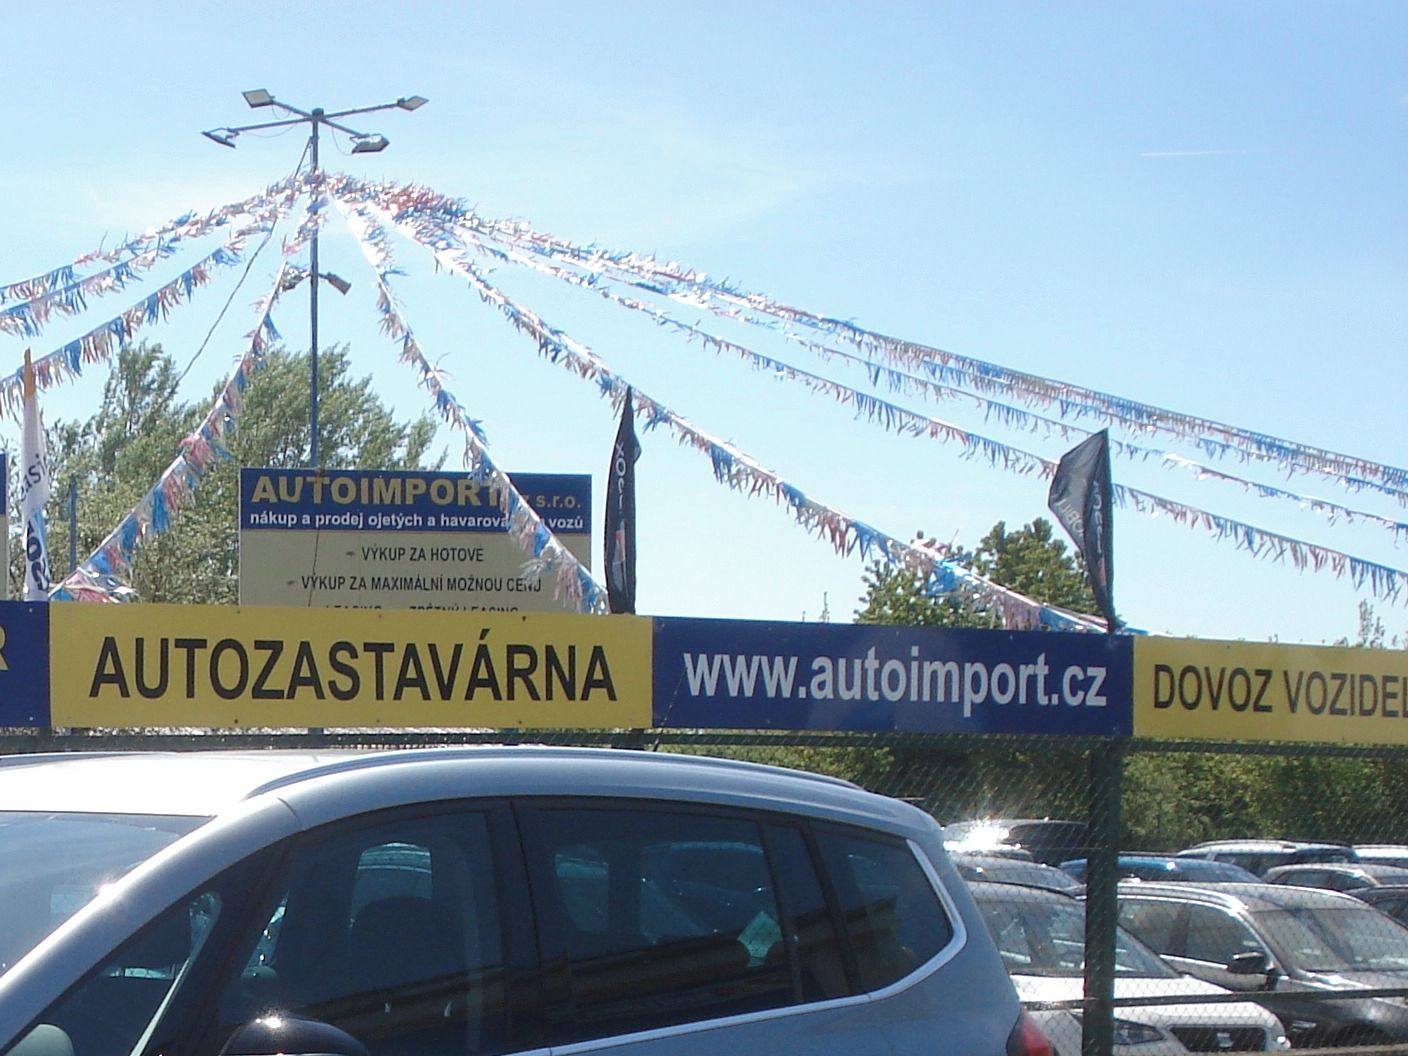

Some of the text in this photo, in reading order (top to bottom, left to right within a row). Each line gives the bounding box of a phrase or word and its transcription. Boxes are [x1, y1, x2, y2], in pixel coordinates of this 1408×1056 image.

[251, 475, 500, 507] AUTOIMPORT
[536, 494, 581, 509] s.r.o.
[250, 511, 298, 528] nákup
[302, 514, 311, 526] a
[315, 512, 364, 529] prodej
[368, 513, 422, 530] ojetých
[427, 515, 436, 526] a
[361, 544, 484, 563] VÝKUP ZA HOTOVÉ
[301, 573, 346, 591] VÝKUP
[349, 576, 367, 591] ZA
[371, 574, 442, 592] MAXIMÁLNÍ
[447, 574, 502, 593] MOŽNOU
[88, 629, 618, 702] AUTOZASTAVÁRNA
[683, 645, 1107, 718] www.autoimport.cz
[1153, 664, 1273, 713] DOVOZ
